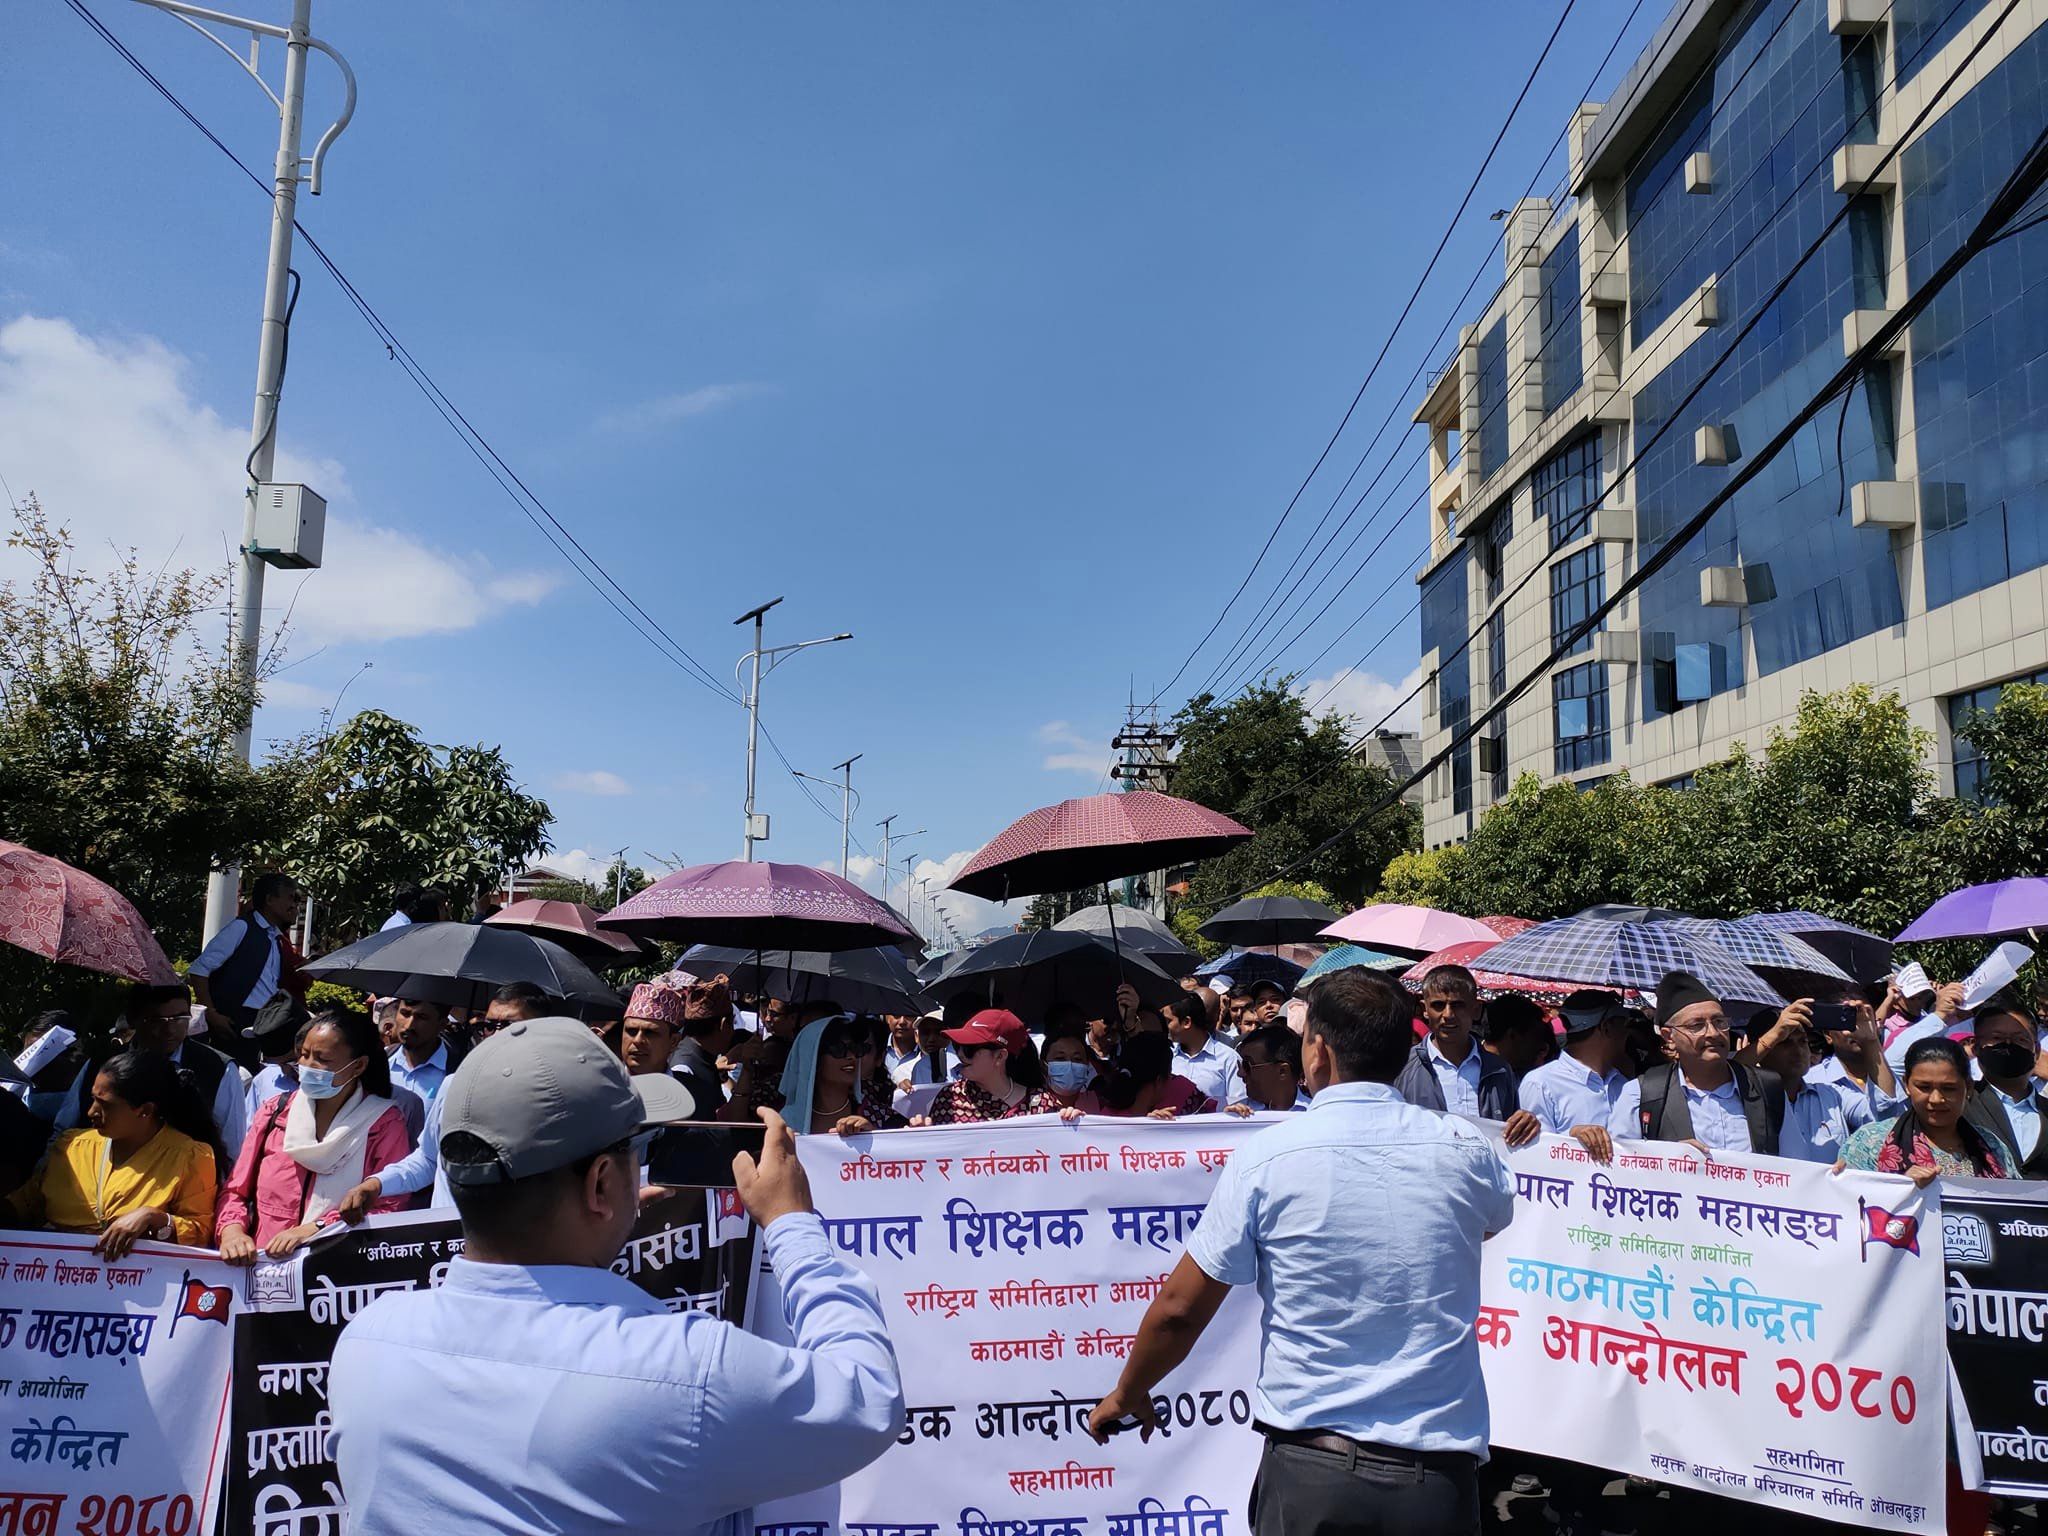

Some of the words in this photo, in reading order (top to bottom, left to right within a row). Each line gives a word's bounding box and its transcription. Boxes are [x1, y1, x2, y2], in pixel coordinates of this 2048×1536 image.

[840, 1154, 927, 1182] अधिकार
[936, 1158, 953, 1182] र
[962, 1149, 1050, 1177] कर्तव्यको
[1060, 1146, 1110, 1175] लागि
[1119, 1145, 1186, 1173] शिक्षक
[1668, 1154, 1698, 1178] लागि
[1704, 1157, 1748, 1182] शिक्षक
[1753, 1169, 1791, 1188] एकता
[943, 1197, 1089, 1258] शिक्षक
[1588, 1173, 1682, 1222] शिक्षक
[1697, 1195, 1842, 1250] महासङ्घ
[430, 1240, 442, 1257] र
[1944, 1225, 1978, 1237] cnt
[1619, 1232, 1685, 1262] समितिद्वारा
[1690, 1243, 1753, 1268] आयोजित
[14, 1257, 48, 1283] लागि
[54, 1259, 101, 1286] शिक्षक
[988, 1279, 1099, 1311] समितिद्वारा
[1507, 1257, 1675, 1321] काठमाडौं
[1689, 1276, 1823, 1344] केन्द्रित
[25, 1309, 158, 1367] महासङ्घ
[969, 1329, 1066, 1362] काठमाडौं
[18, 1375, 90, 1400] आयोजित
[1543, 1313, 1748, 1396] आन्दोलन
[1775, 1357, 1917, 1426] २०८०
[10, 1415, 130, 1471] केन्द्रित
[1008, 1461, 1115, 1496] सहभागिता
[1766, 1448, 1845, 1476] सहभागिता
[1651, 1452, 1686, 1475] संयुक्त
[1692, 1463, 1748, 1488] आन्दोलन
[1753, 1474, 1815, 1502] परिचालन
[1822, 1487, 1865, 1511] समिति
[76, 1493, 194, 1536] २०८०
